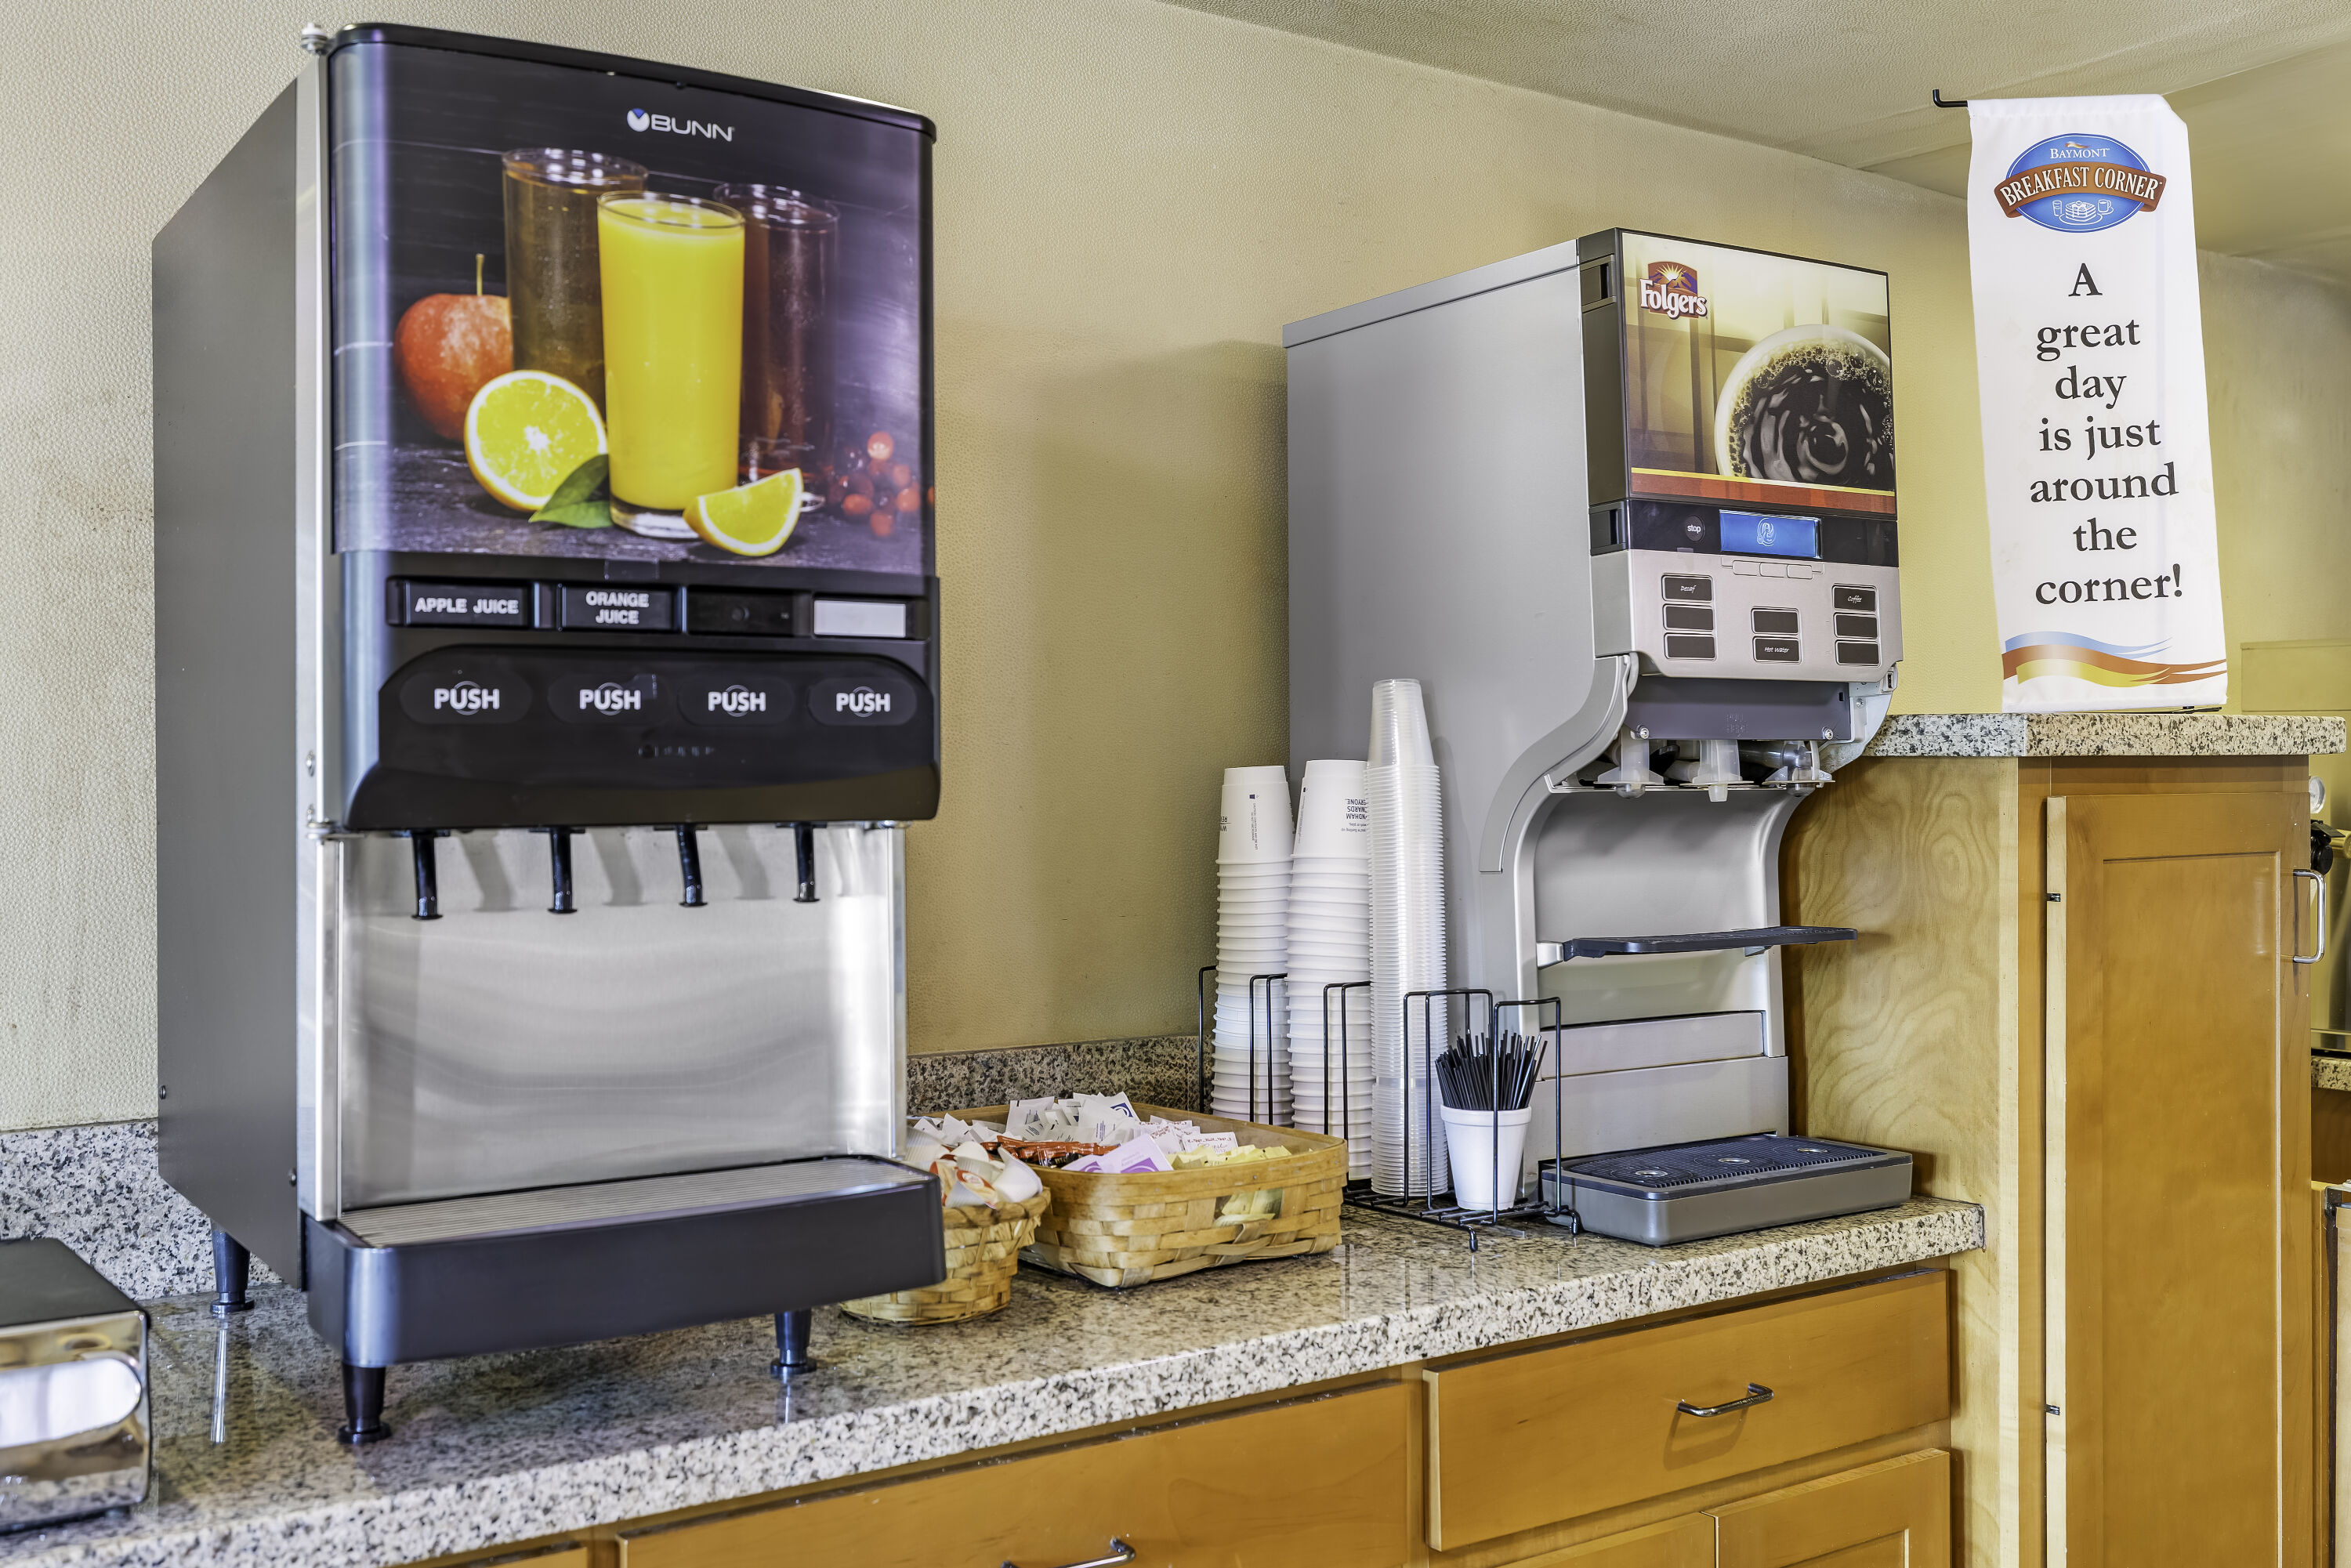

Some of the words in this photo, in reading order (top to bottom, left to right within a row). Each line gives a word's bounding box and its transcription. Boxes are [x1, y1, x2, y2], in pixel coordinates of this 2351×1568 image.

[651, 114, 733, 142] BUNN
[2049, 147, 2108, 159] BAYMONT
[1999, 166, 2089, 207] BREAKFAST
[2094, 167, 2160, 201] CORNER
[2068, 263, 2103, 297] A
[1639, 278, 1708, 319] Folgers
[2037, 319, 2141, 362] great
[2055, 364, 2127, 410] day
[2038, 417, 2071, 451] is
[2085, 415, 2161, 461] just
[2030, 461, 2179, 503] around
[1687, 523, 1701, 534] stop
[2073, 517, 2138, 552] the
[1680, 585, 1697, 594] Decaf
[2035, 563, 2183, 605] corner!
[415, 597, 468, 614] APPLE
[473, 599, 519, 614] JUICE
[585, 591, 650, 608] ORANGE
[1847, 595, 1862, 604] Coffee
[595, 609, 639, 625] JUICE
[434, 688, 500, 710] PUSH
[579, 689, 641, 710] PUSH
[708, 691, 766, 712] PUSH
[836, 693, 890, 712] PUSH
